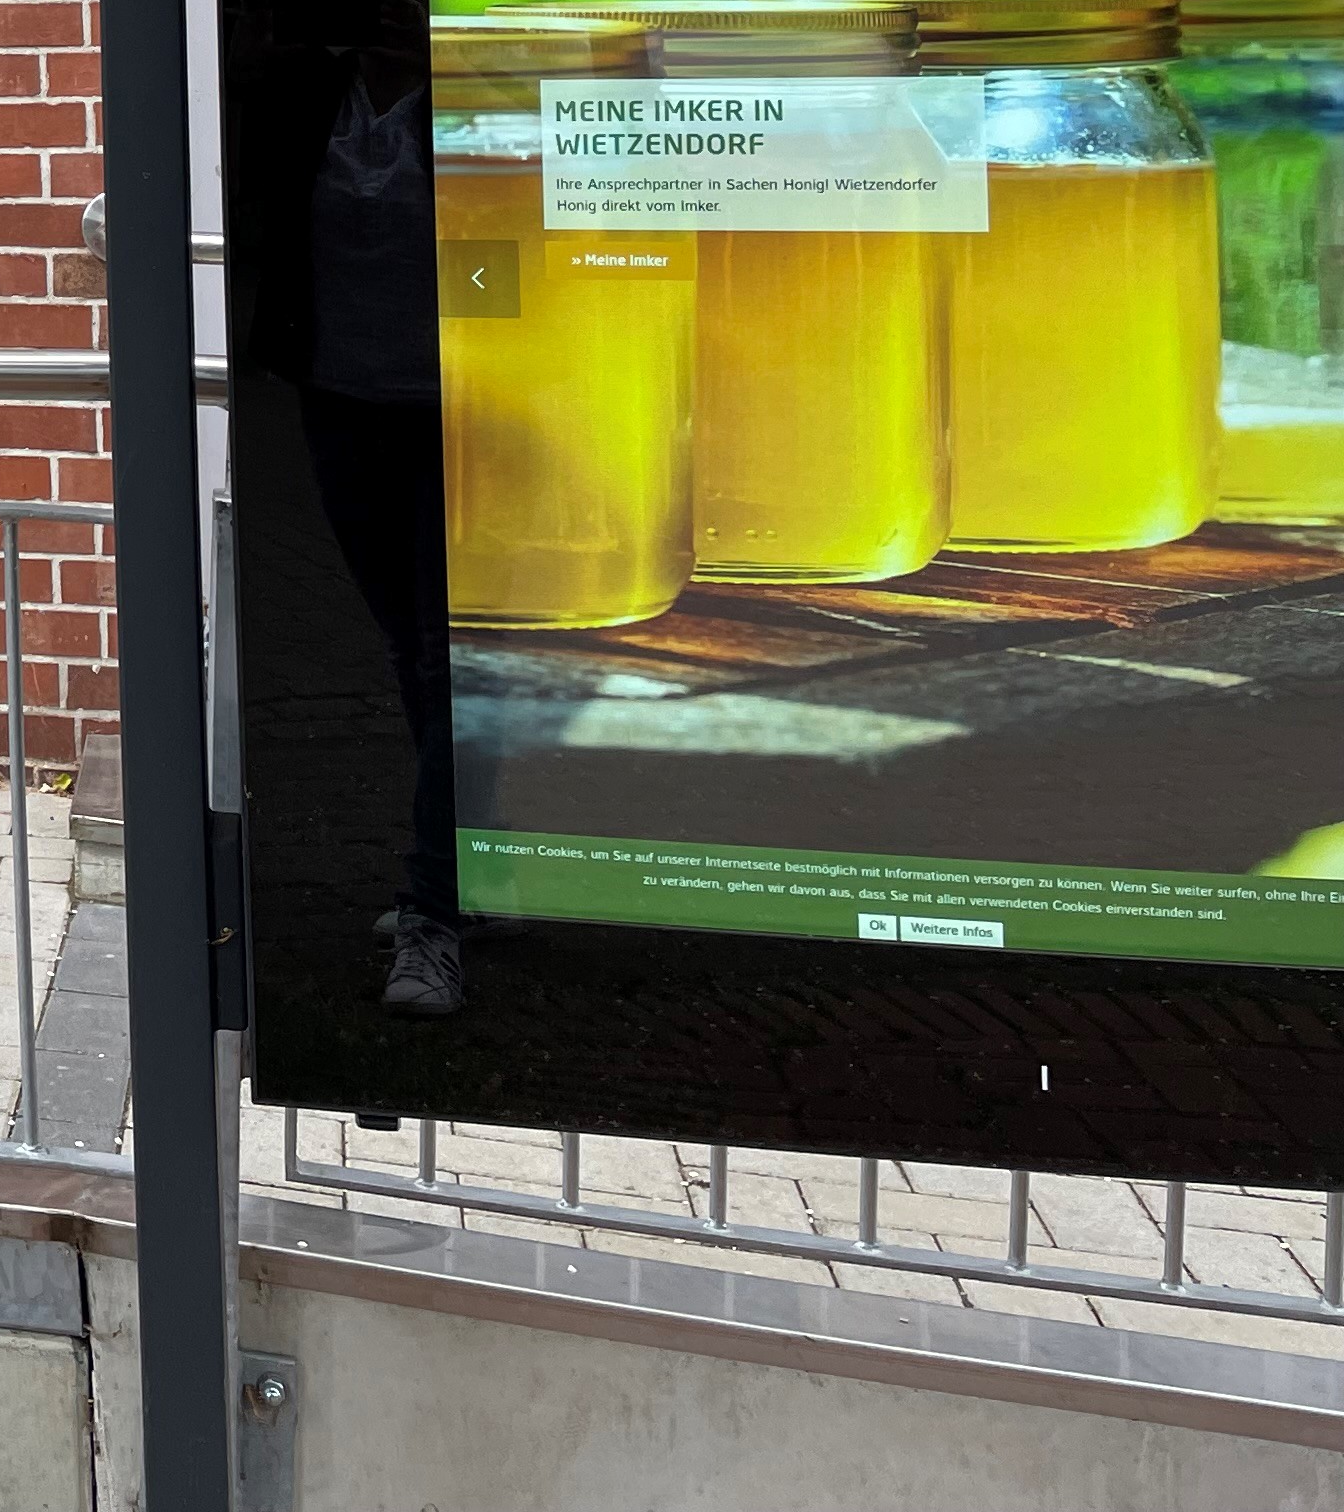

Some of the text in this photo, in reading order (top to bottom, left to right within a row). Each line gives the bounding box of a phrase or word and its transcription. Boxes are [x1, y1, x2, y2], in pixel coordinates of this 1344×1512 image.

[555, 99, 784, 122] MEINE IMKER IN
[556, 133, 765, 156] WIETZENDORF
[556, 178, 583, 191] Ihre
[587, 178, 703, 194] Ansprechpartner
[708, 178, 721, 191] in
[726, 178, 779, 191] Sachen
[835, 178, 938, 191] Wietzendorfer
[557, 200, 722, 215] Honig direkt vom Imker.
[585, 254, 669, 267] Meine Imker
[472, 841, 491, 852] Wir
[495, 843, 534, 855] nutzen
[537, 844, 587, 861] Cookies,
[590, 850, 609, 861] um
[613, 849, 631, 862] Sie
[635, 852, 654, 863] auf
[657, 855, 702, 867] unserer
[705, 856, 781, 872] Internetseite
[784, 861, 857, 878] bestmöglich
[861, 866, 881, 878] mit
[884, 867, 969, 883] Informationen
[973, 874, 1034, 889] versorgen
[1038, 878, 1053, 888] zu
[1057, 876, 1105, 891] können.
[1110, 880, 1147, 894] Wenn
[1151, 883, 1170, 895] Sie
[1175, 884, 1214, 897] weiter
[1217, 887, 1261, 901] surfen,
[1265, 889, 1297, 902] ohne
[1301, 890, 1326, 903] Ihre
[643, 875, 1227, 921] zu verändern, gehen wir davon aus, dass Sie mit allen verwendeten Cookies einverstanden sind.
[869, 919, 887, 932] Ok
[911, 922, 993, 938] Weitere Infos
